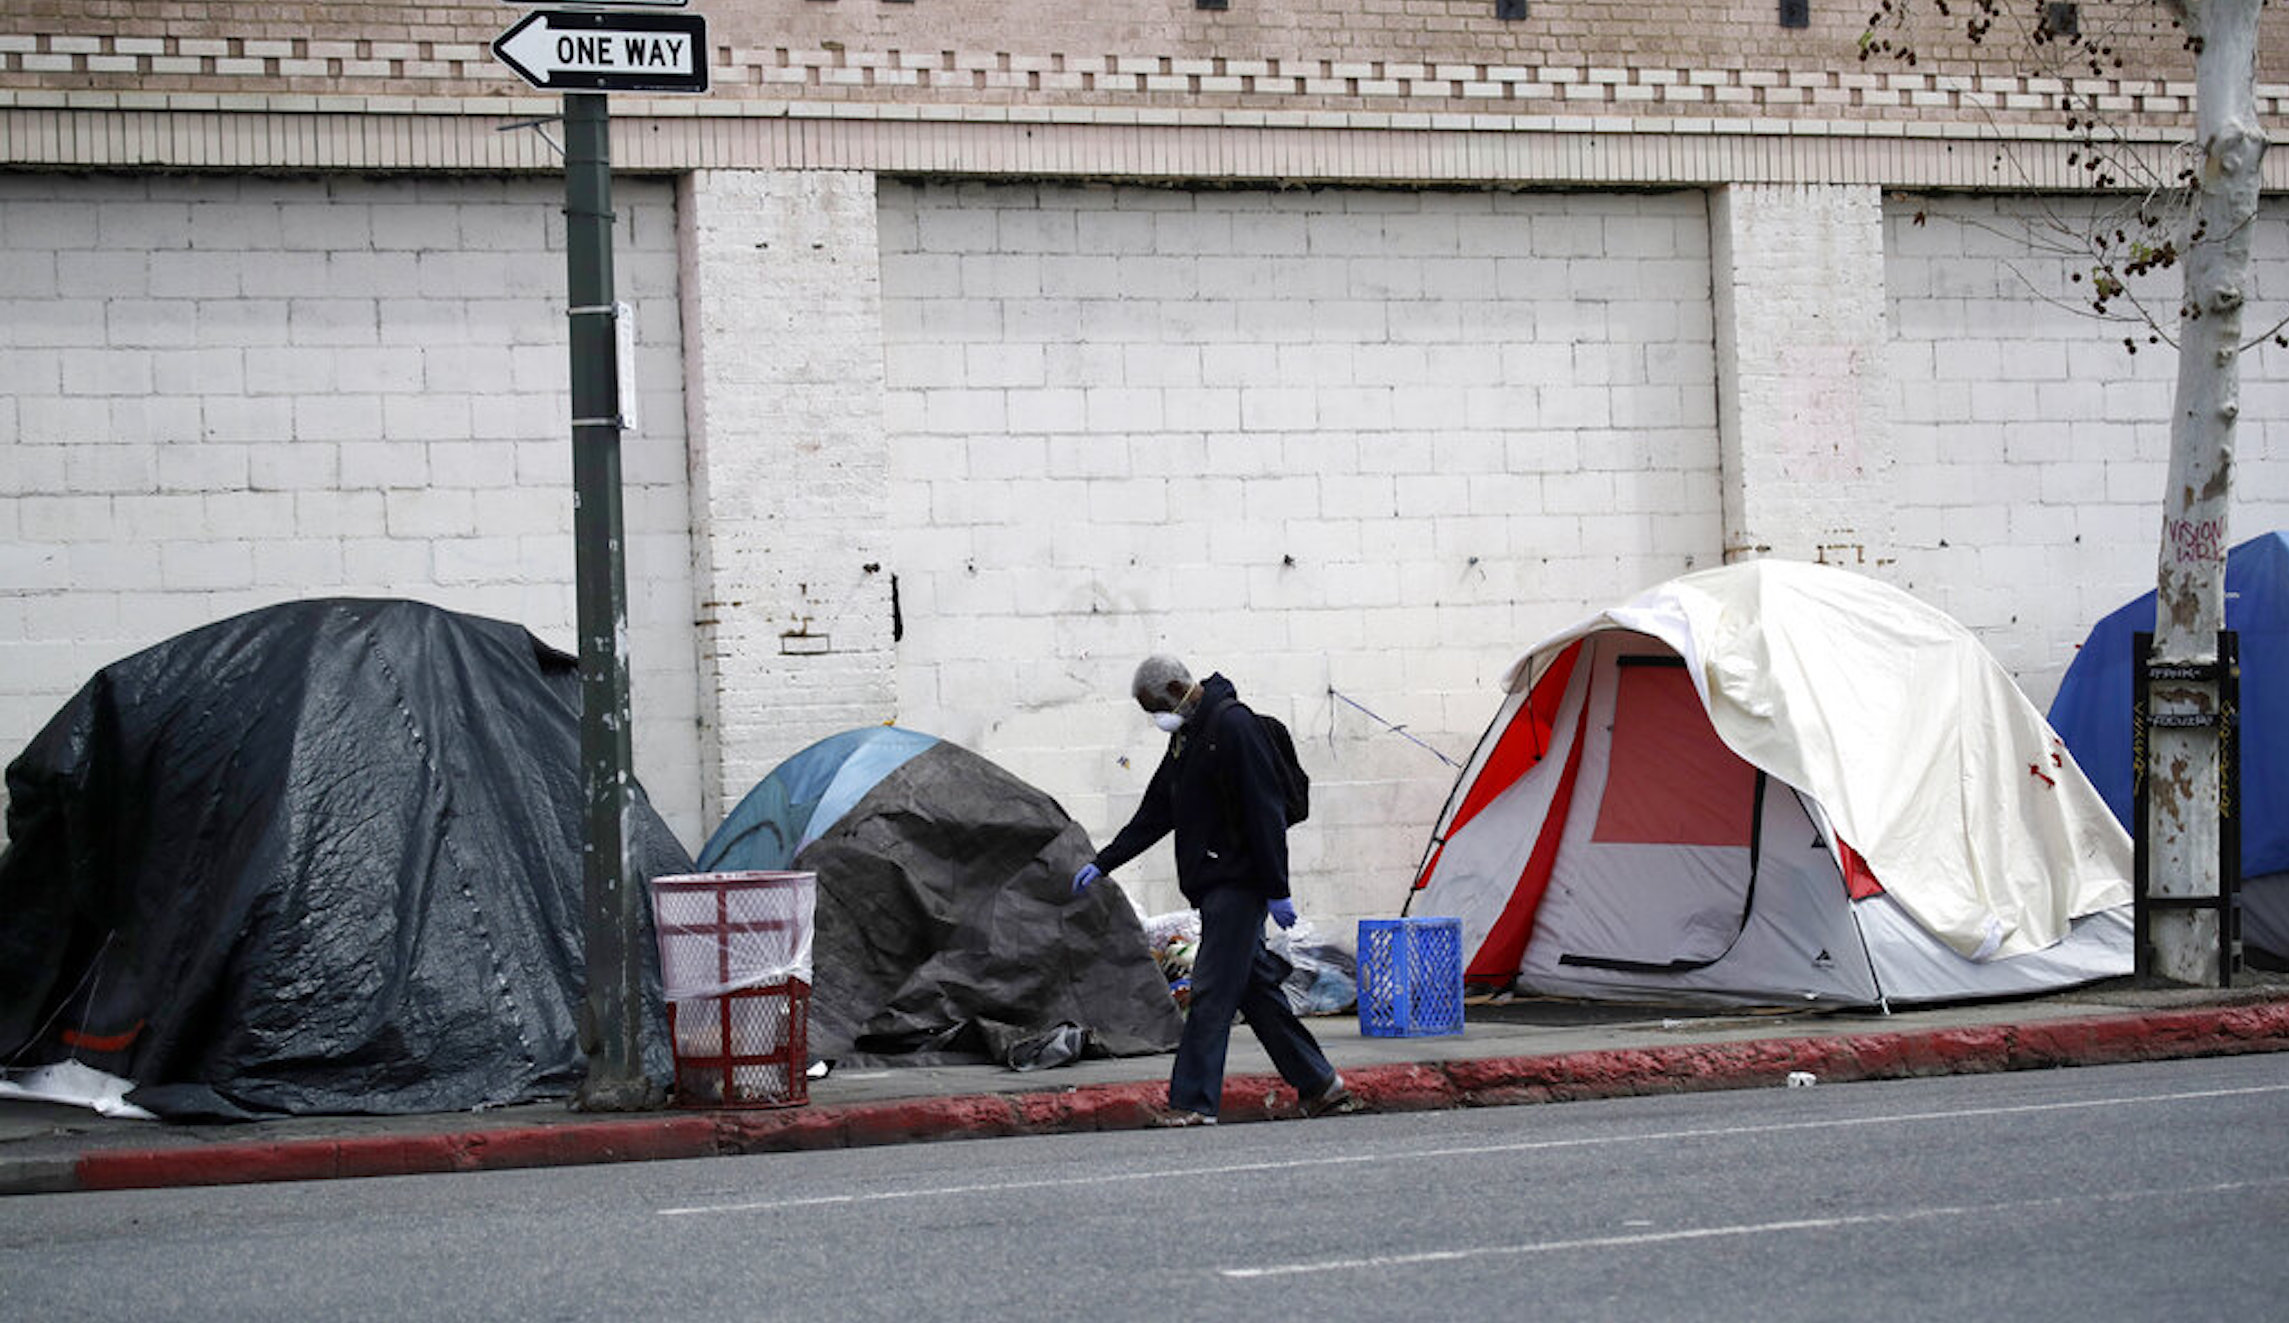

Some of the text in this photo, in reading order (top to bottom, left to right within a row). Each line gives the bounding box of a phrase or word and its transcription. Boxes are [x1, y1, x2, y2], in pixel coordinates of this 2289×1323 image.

[557, 36, 683, 67] ONE WAY
[2169, 516, 2224, 547] VISION
